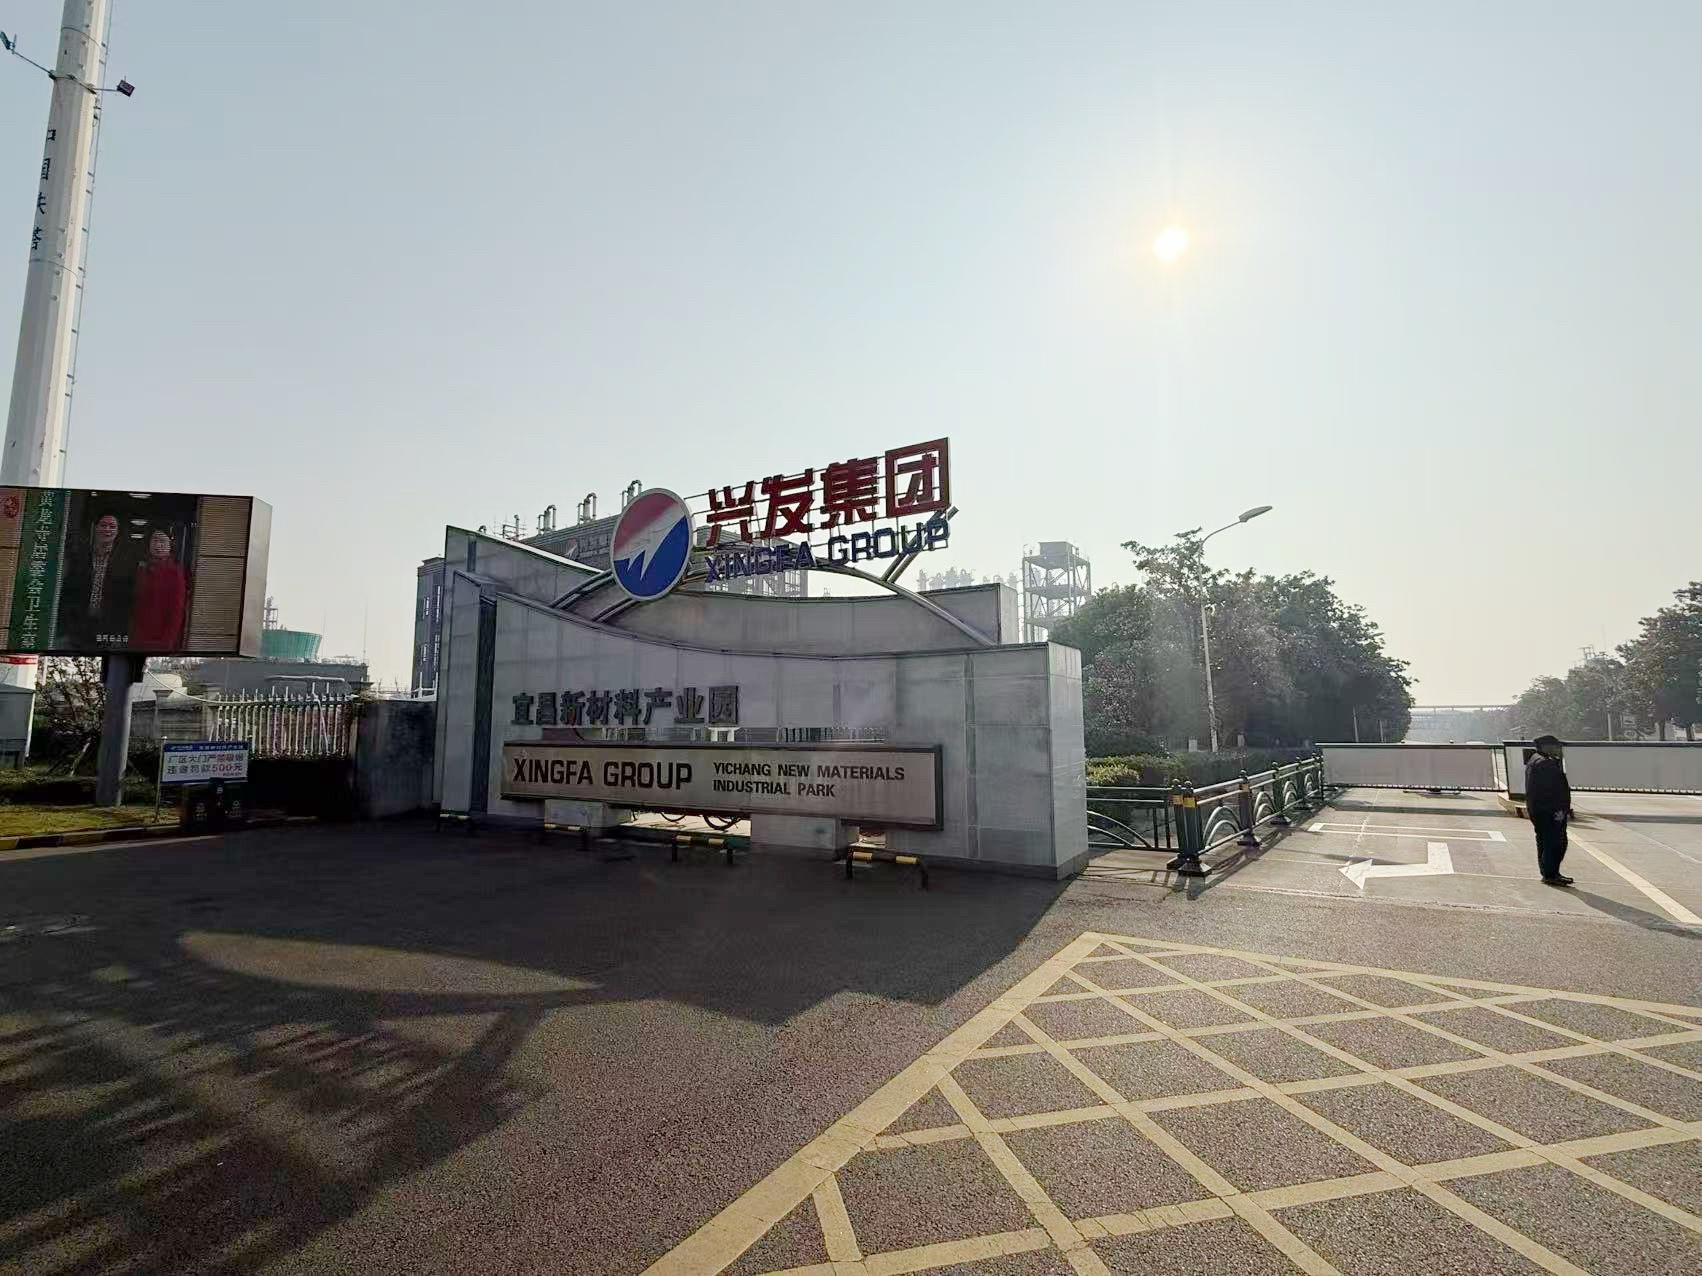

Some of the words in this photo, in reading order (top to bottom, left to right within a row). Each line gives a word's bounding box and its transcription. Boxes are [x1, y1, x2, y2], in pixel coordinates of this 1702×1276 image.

[706, 437, 952, 546] 兴发集团
[705, 540, 815, 583] XINGFA
[827, 517, 951, 566] GROUP
[511, 685, 740, 726] 宜昌新材料产业园
[513, 758, 593, 785] XINGFA
[603, 760, 693, 790] GROUP
[713, 762, 772, 777] YICHANG
[777, 763, 810, 778] NEW
[817, 764, 905, 781] MATERIALS
[713, 778, 791, 796] INDUSTRIAL
[797, 783, 835, 797] PARK
